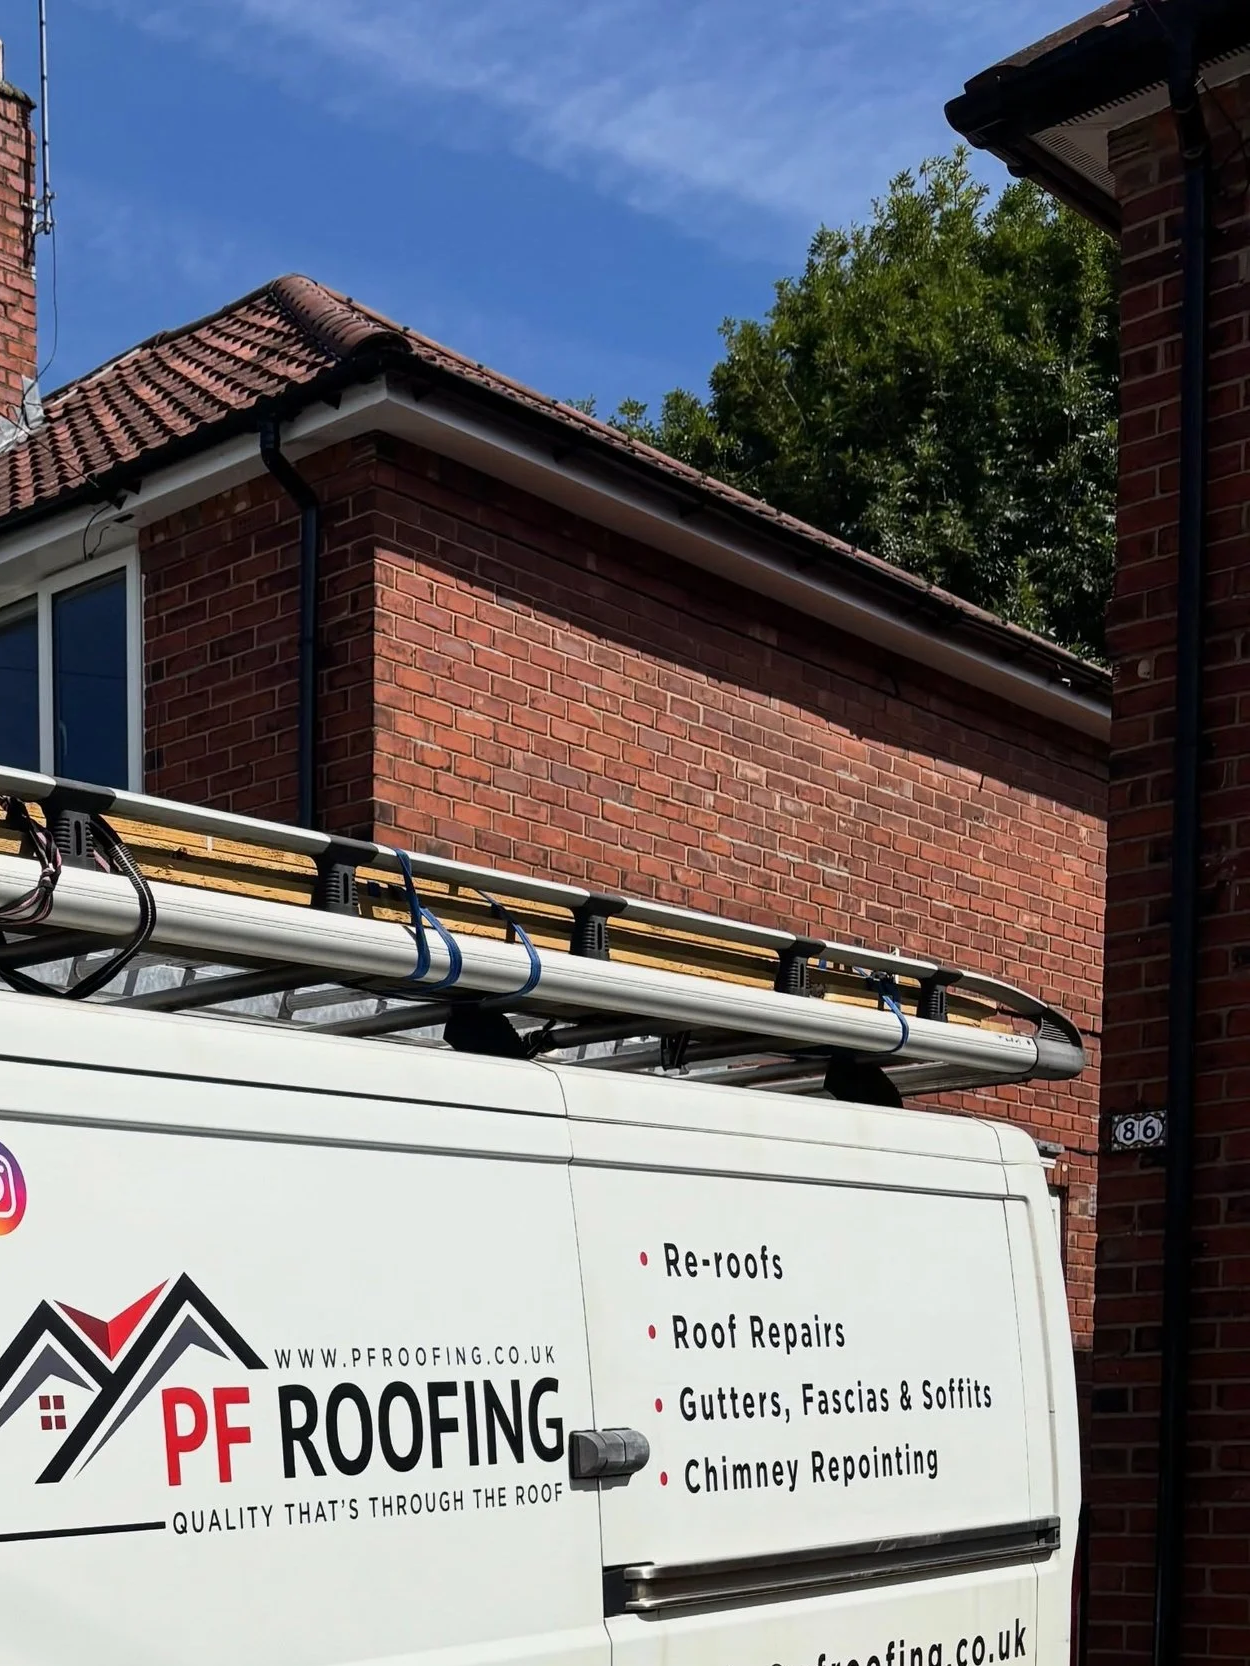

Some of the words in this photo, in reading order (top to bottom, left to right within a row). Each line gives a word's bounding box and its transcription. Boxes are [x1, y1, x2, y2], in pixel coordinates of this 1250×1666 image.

[1122, 1118, 1156, 1141] 86
[663, 1242, 783, 1280] Re-roofs
[672, 1314, 737, 1349] Roof
[749, 1314, 845, 1355] Repairs
[274, 1345, 556, 1369] WWW.PFROOFING.CO.UK
[679, 1386, 790, 1424] Gutters,
[801, 1380, 889, 1416] Fascias
[899, 1380, 913, 1411] &
[922, 1377, 992, 1410] Soffits
[161, 1386, 252, 1487] PF
[277, 1376, 565, 1479] ROOFING
[684, 1455, 799, 1494] Chimney
[811, 1443, 938, 1488] Repointing
[172, 1504, 273, 1535] QUALITY
[284, 1498, 359, 1525] THAT’S
[368, 1490, 464, 1518] THROUGH
[472, 1486, 507, 1509] THE
[515, 1482, 563, 1506] ROOF
